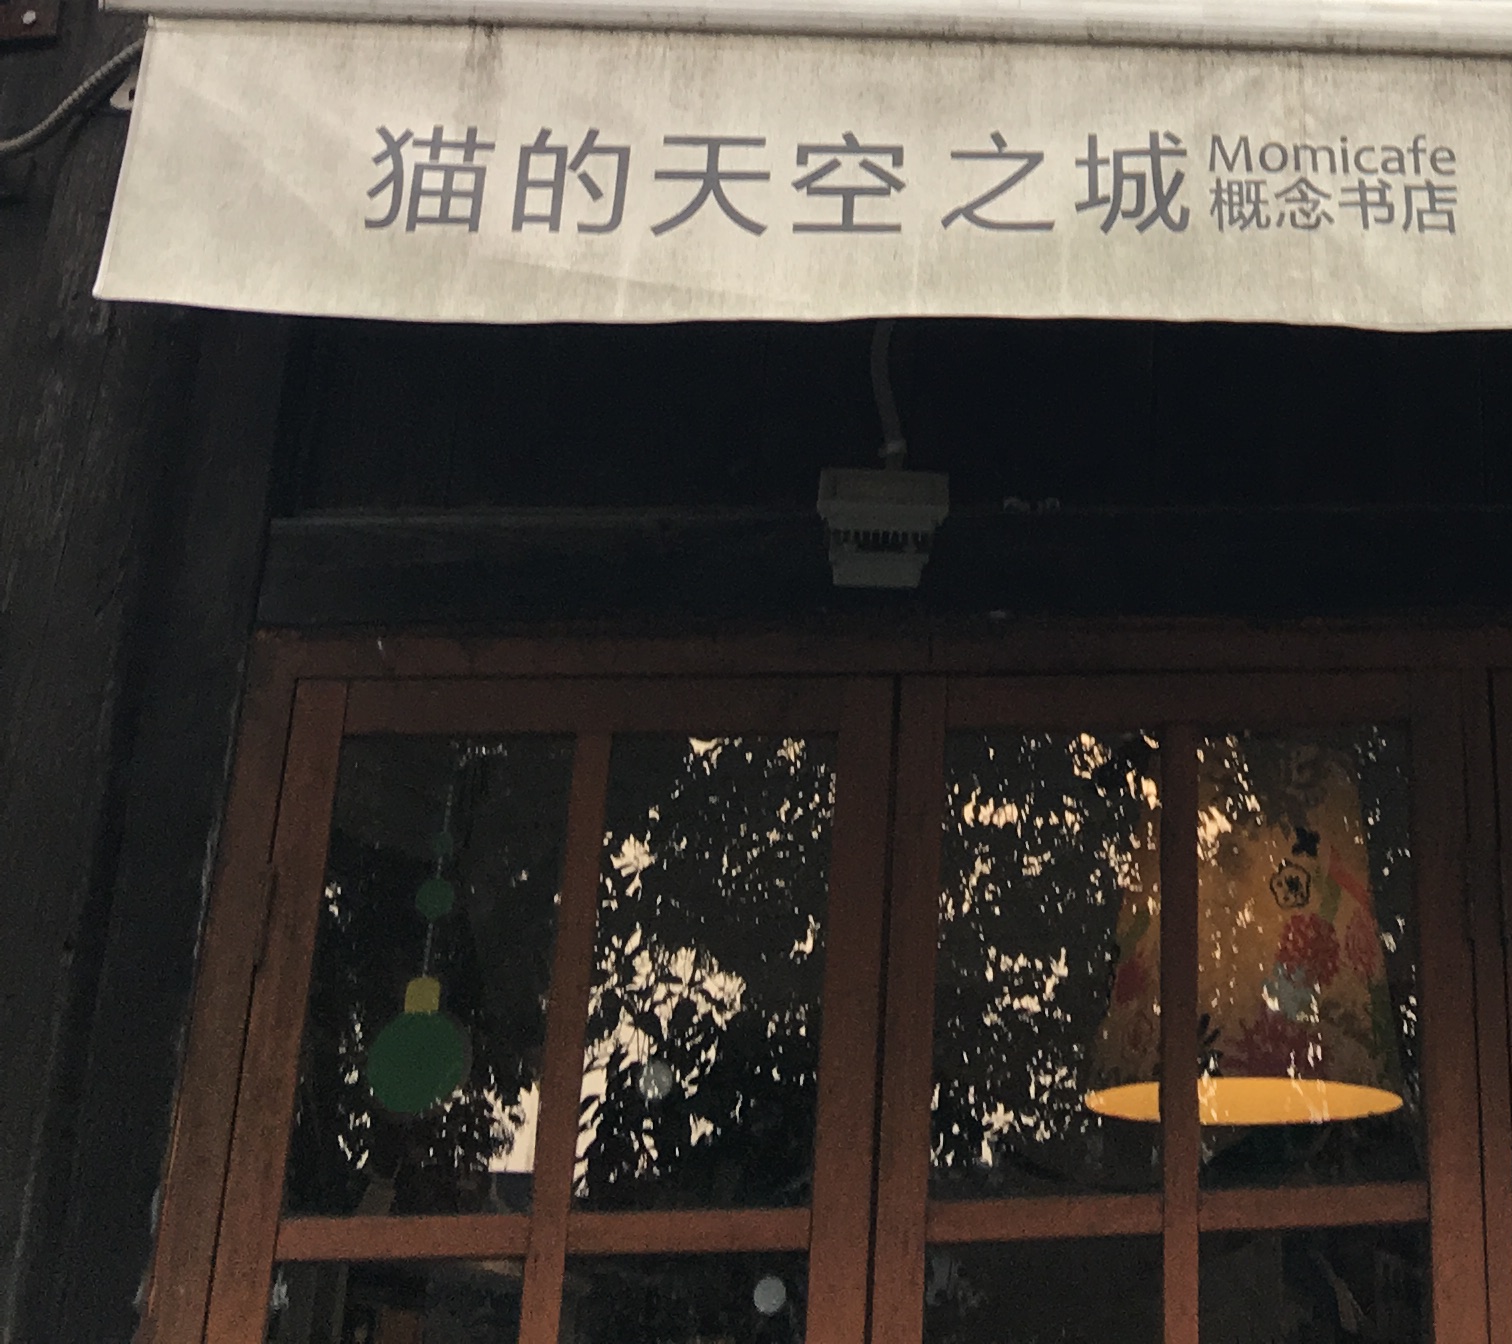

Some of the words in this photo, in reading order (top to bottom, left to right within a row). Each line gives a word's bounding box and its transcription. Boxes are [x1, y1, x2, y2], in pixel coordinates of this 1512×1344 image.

[364, 124, 1191, 236] 猫的天空之城
[1208, 133, 1457, 175] Momicafe
[1208, 176, 1458, 234] 概念书店
